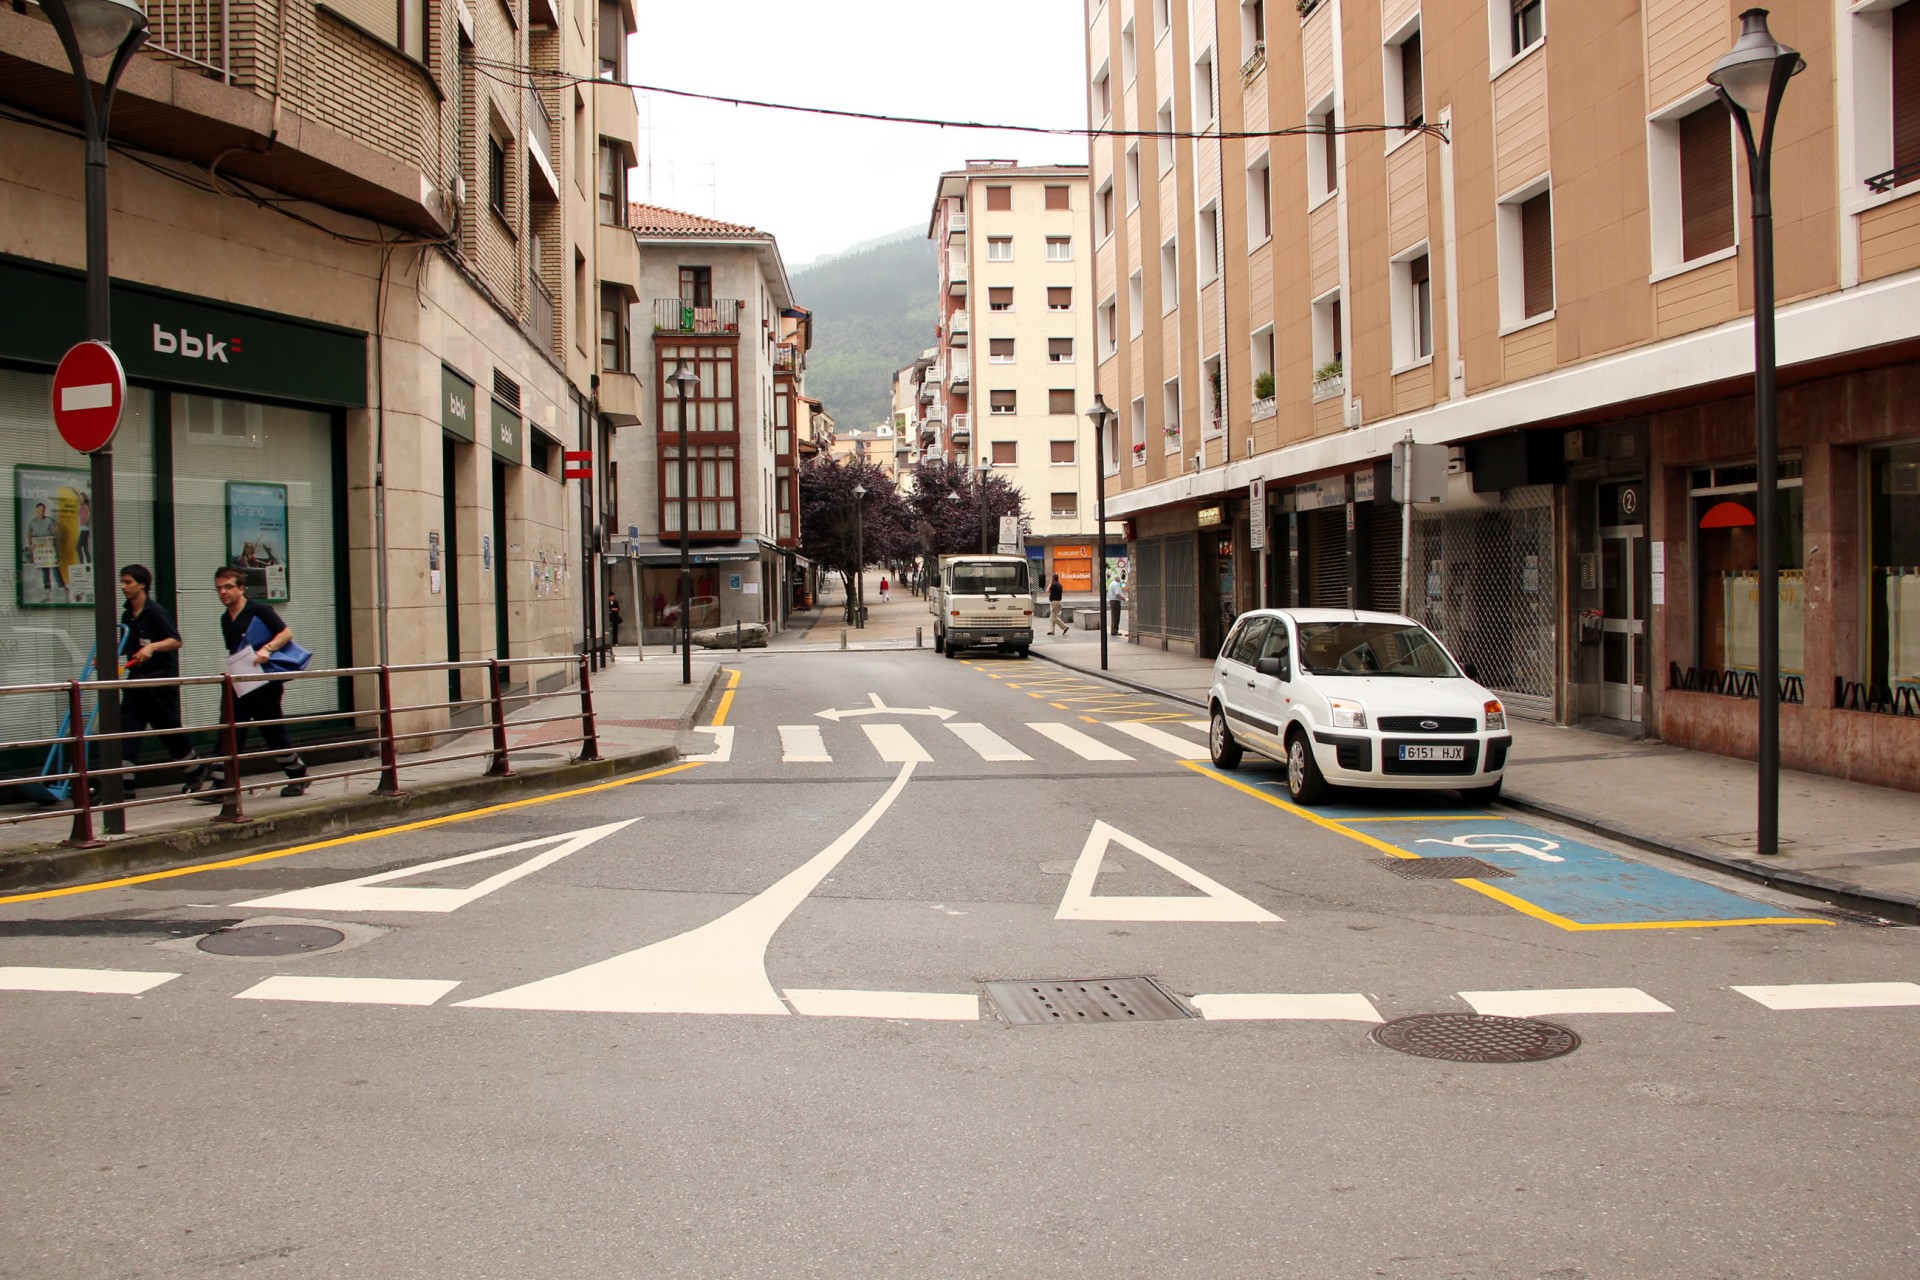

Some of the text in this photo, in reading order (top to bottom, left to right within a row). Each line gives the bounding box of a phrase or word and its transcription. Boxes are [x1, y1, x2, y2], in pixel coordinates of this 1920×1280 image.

[153, 323, 229, 363] bbk
[450, 392, 466, 421] bbk
[501, 423, 513, 446] bbk
[233, 505, 265, 517] verano
[1627, 494, 1632, 509] 2
[1407, 747, 1433, 759] 6151
[1442, 747, 1462, 759] HJX
